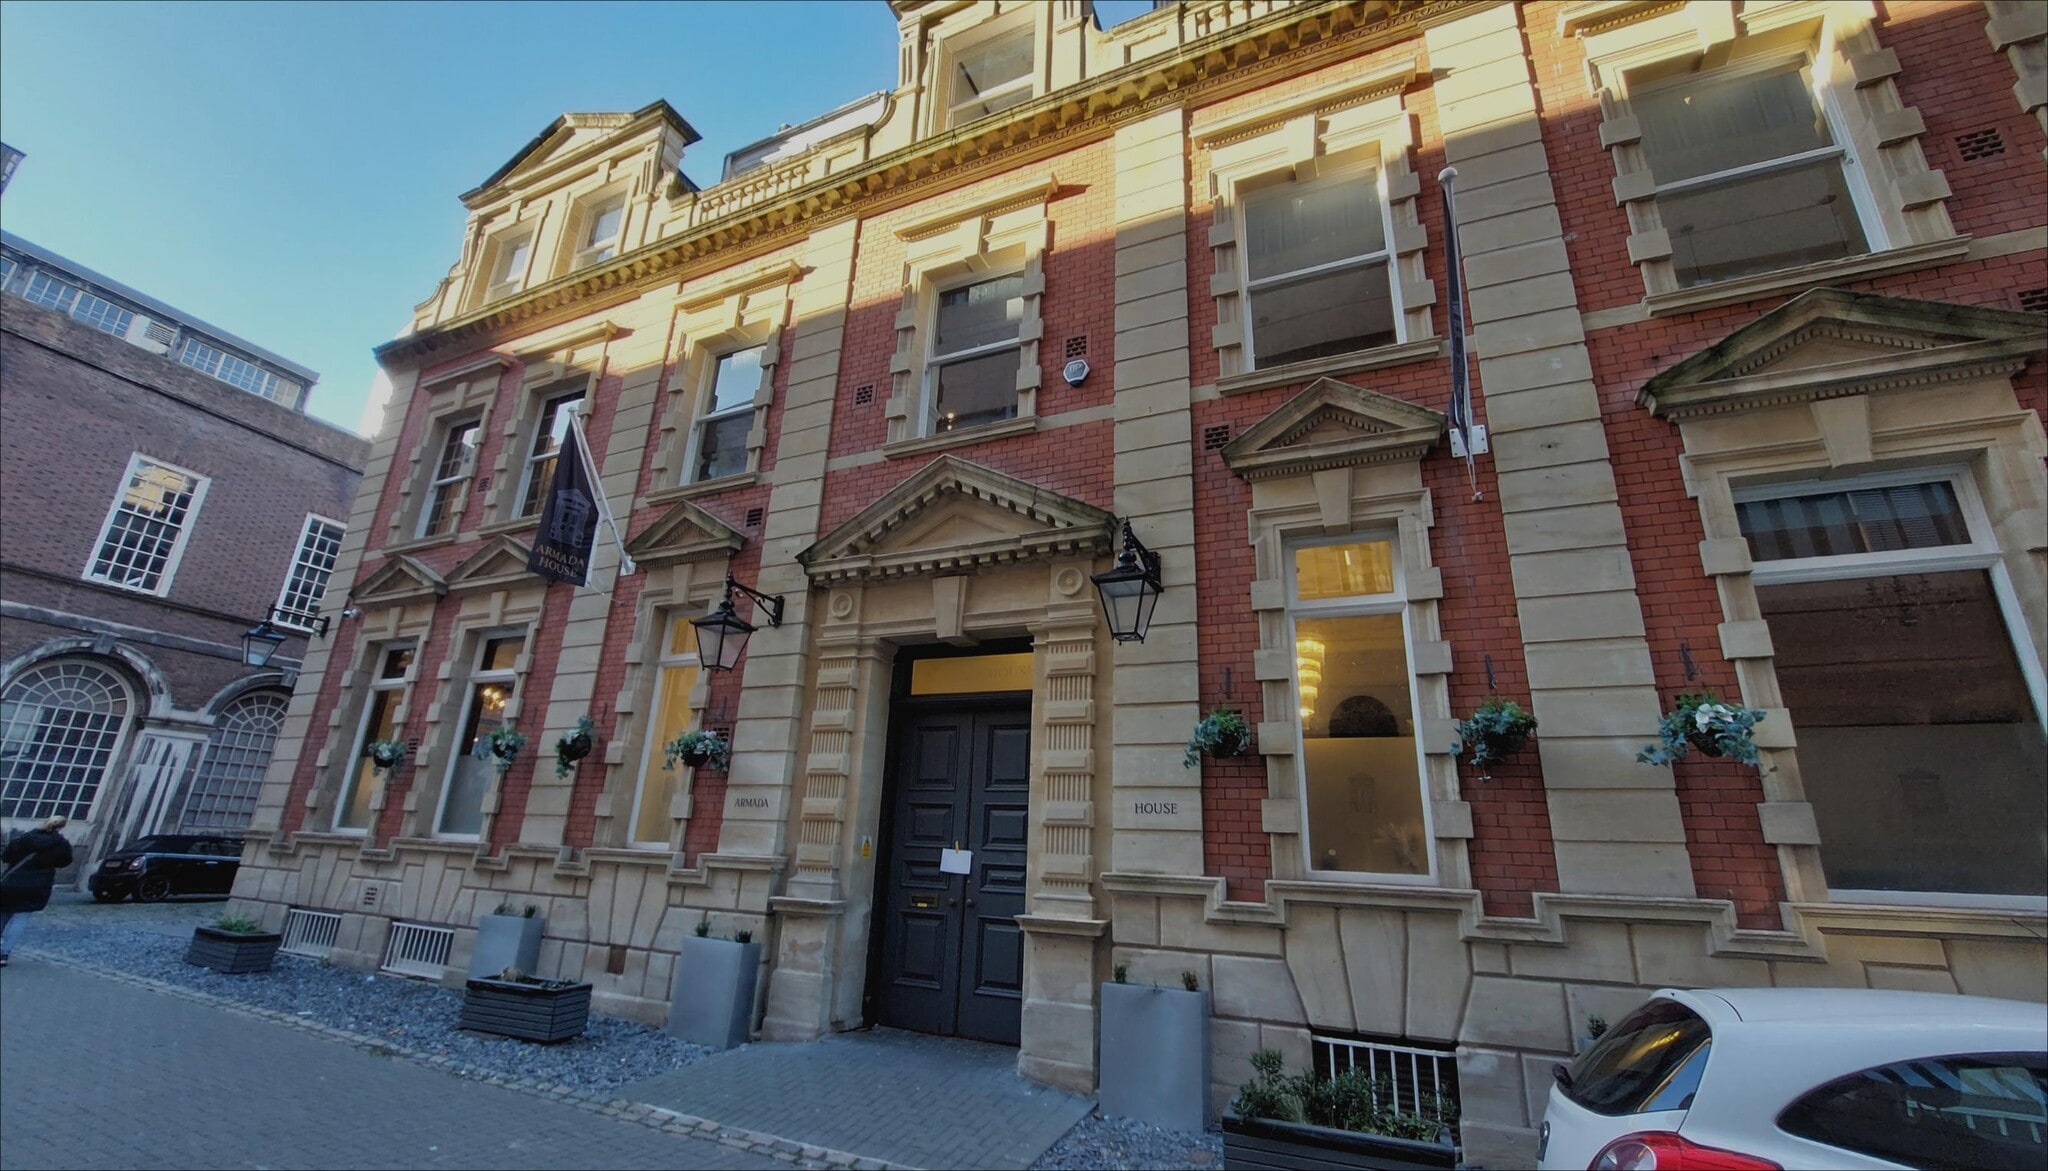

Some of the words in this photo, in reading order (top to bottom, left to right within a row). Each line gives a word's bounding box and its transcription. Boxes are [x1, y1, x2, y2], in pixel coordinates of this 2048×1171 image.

[536, 545, 585, 568] ARMADA
[539, 556, 578, 578] HOUSE
[734, 797, 769, 808] ARMADA
[1135, 802, 1178, 814] HOUSE
